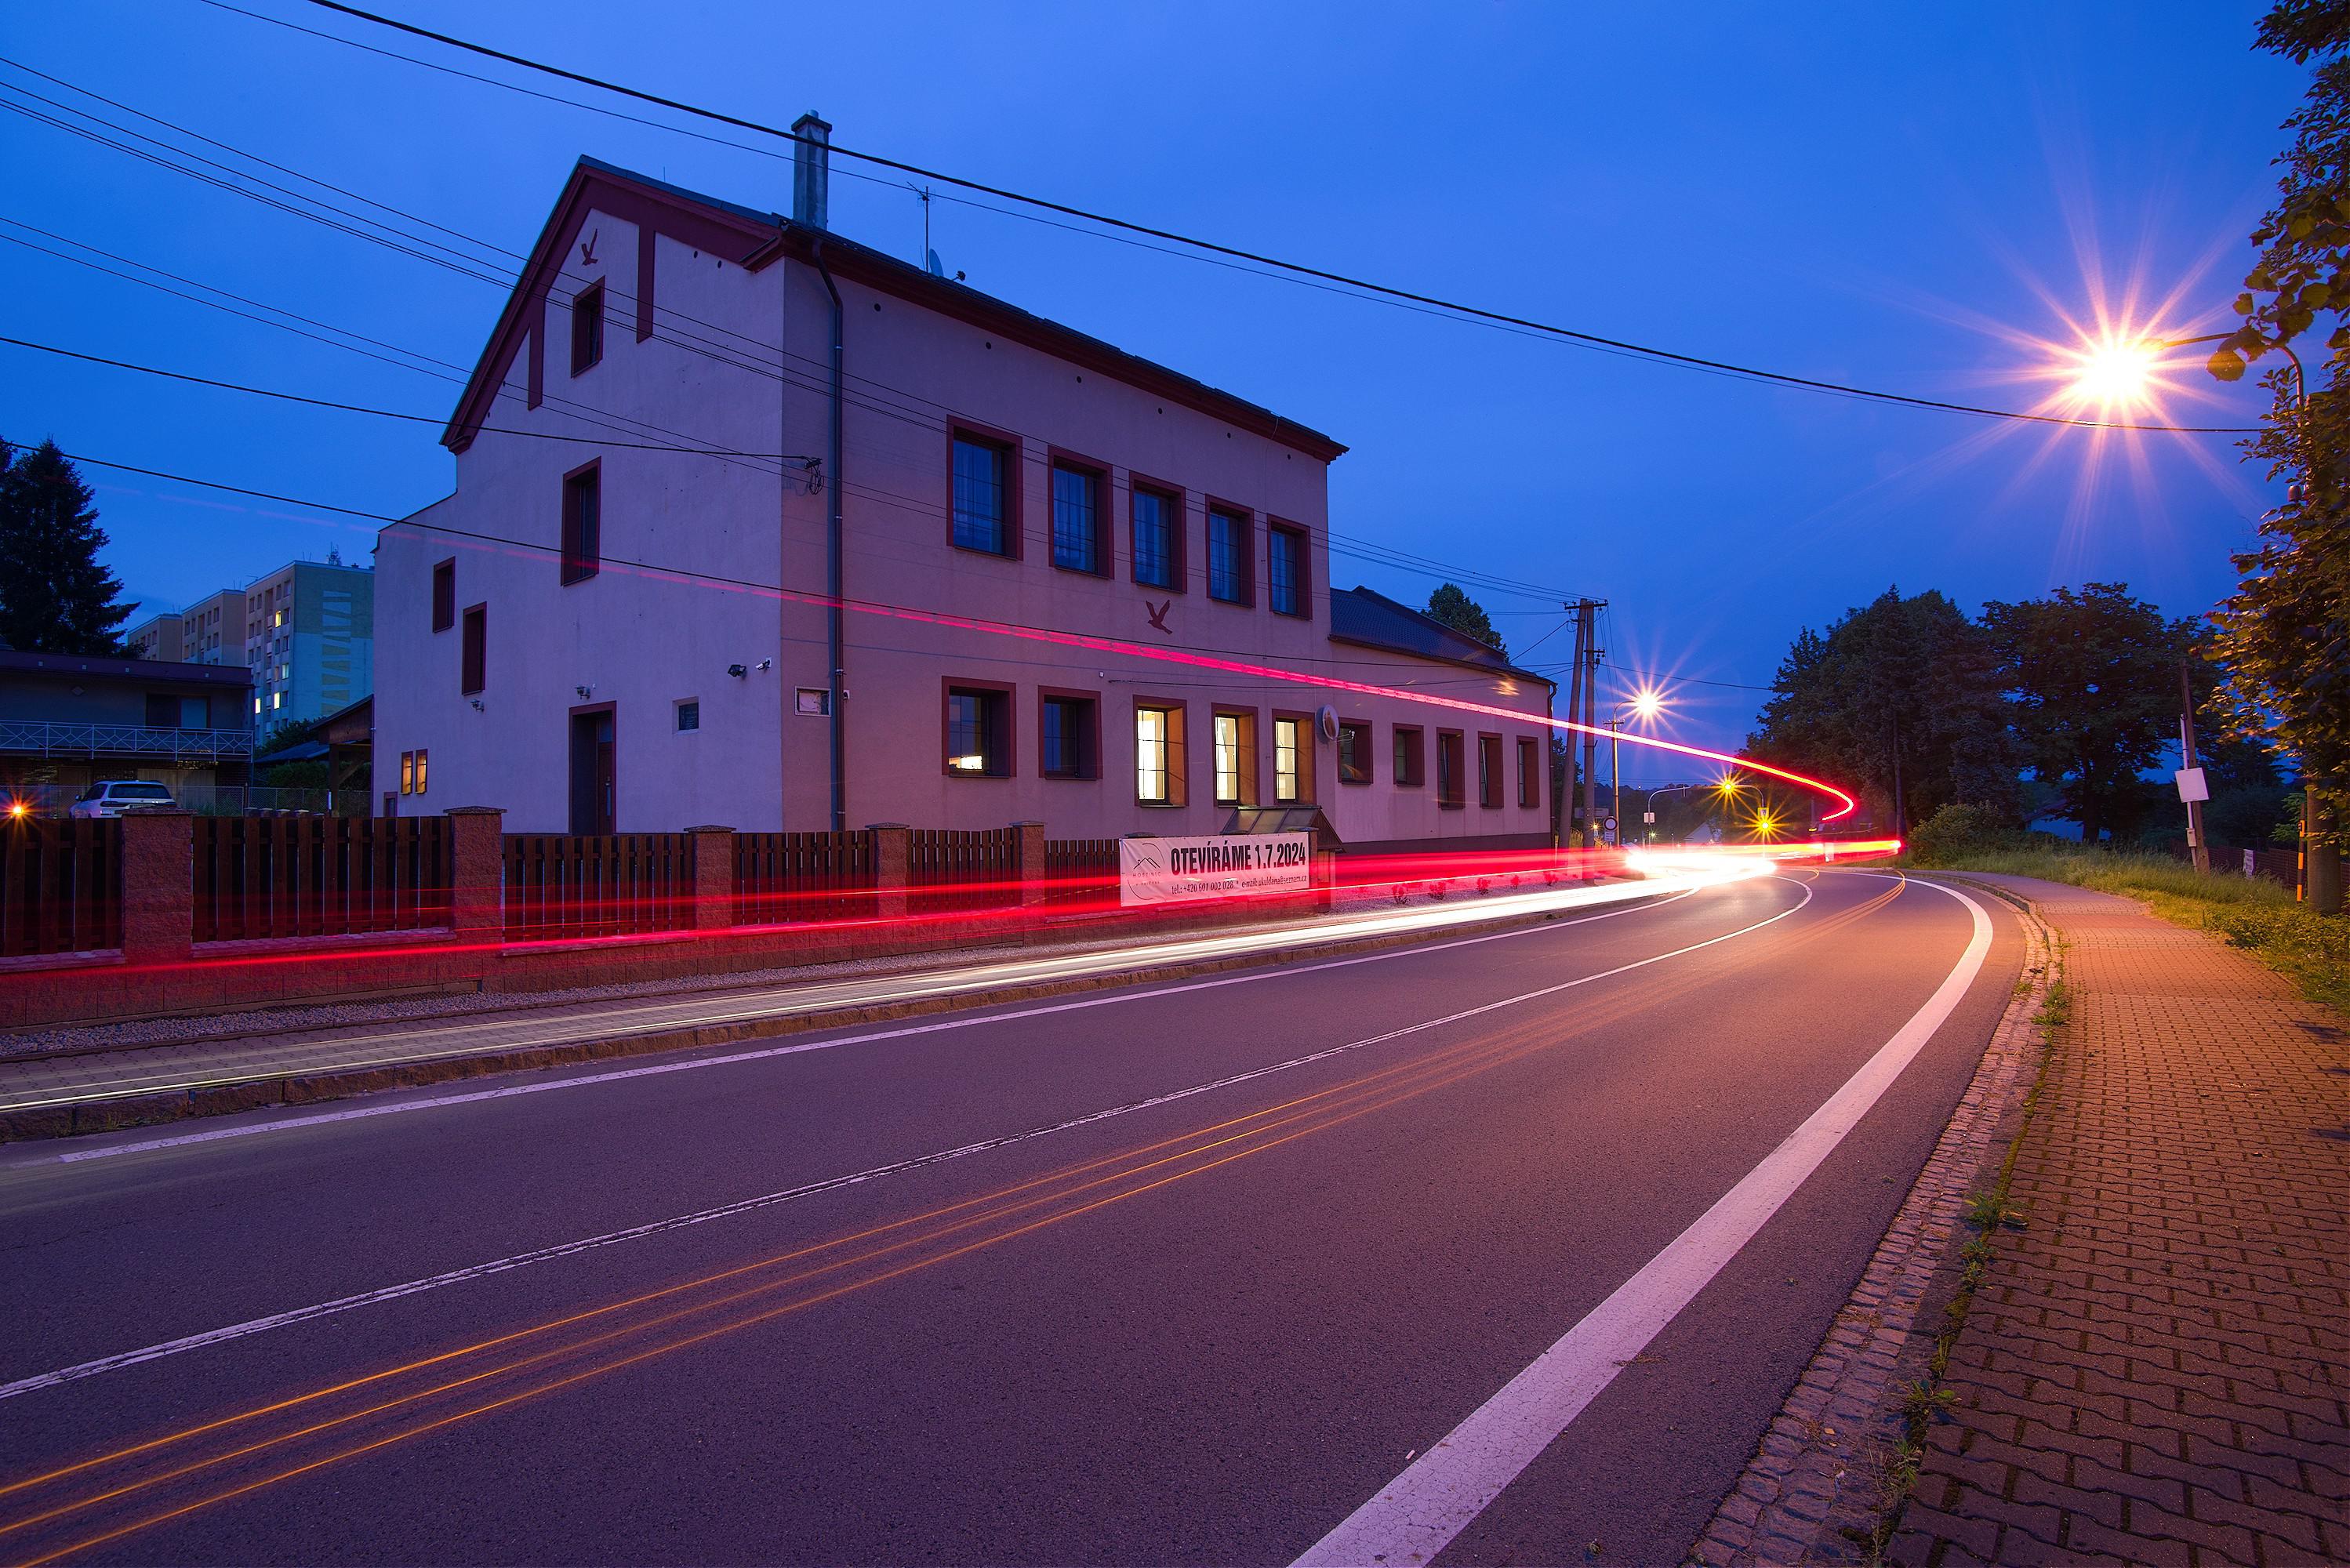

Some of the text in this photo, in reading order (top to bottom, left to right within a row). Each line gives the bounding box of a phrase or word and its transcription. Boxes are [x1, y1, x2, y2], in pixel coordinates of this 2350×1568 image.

[1171, 840, 1306, 876] OTEVÍRÁME 1.7.2024
[1171, 884, 1182, 895] tel.:
[1183, 884, 1197, 893] +420
[1210, 881, 1221, 891] 002
[1222, 880, 1234, 890] 028
